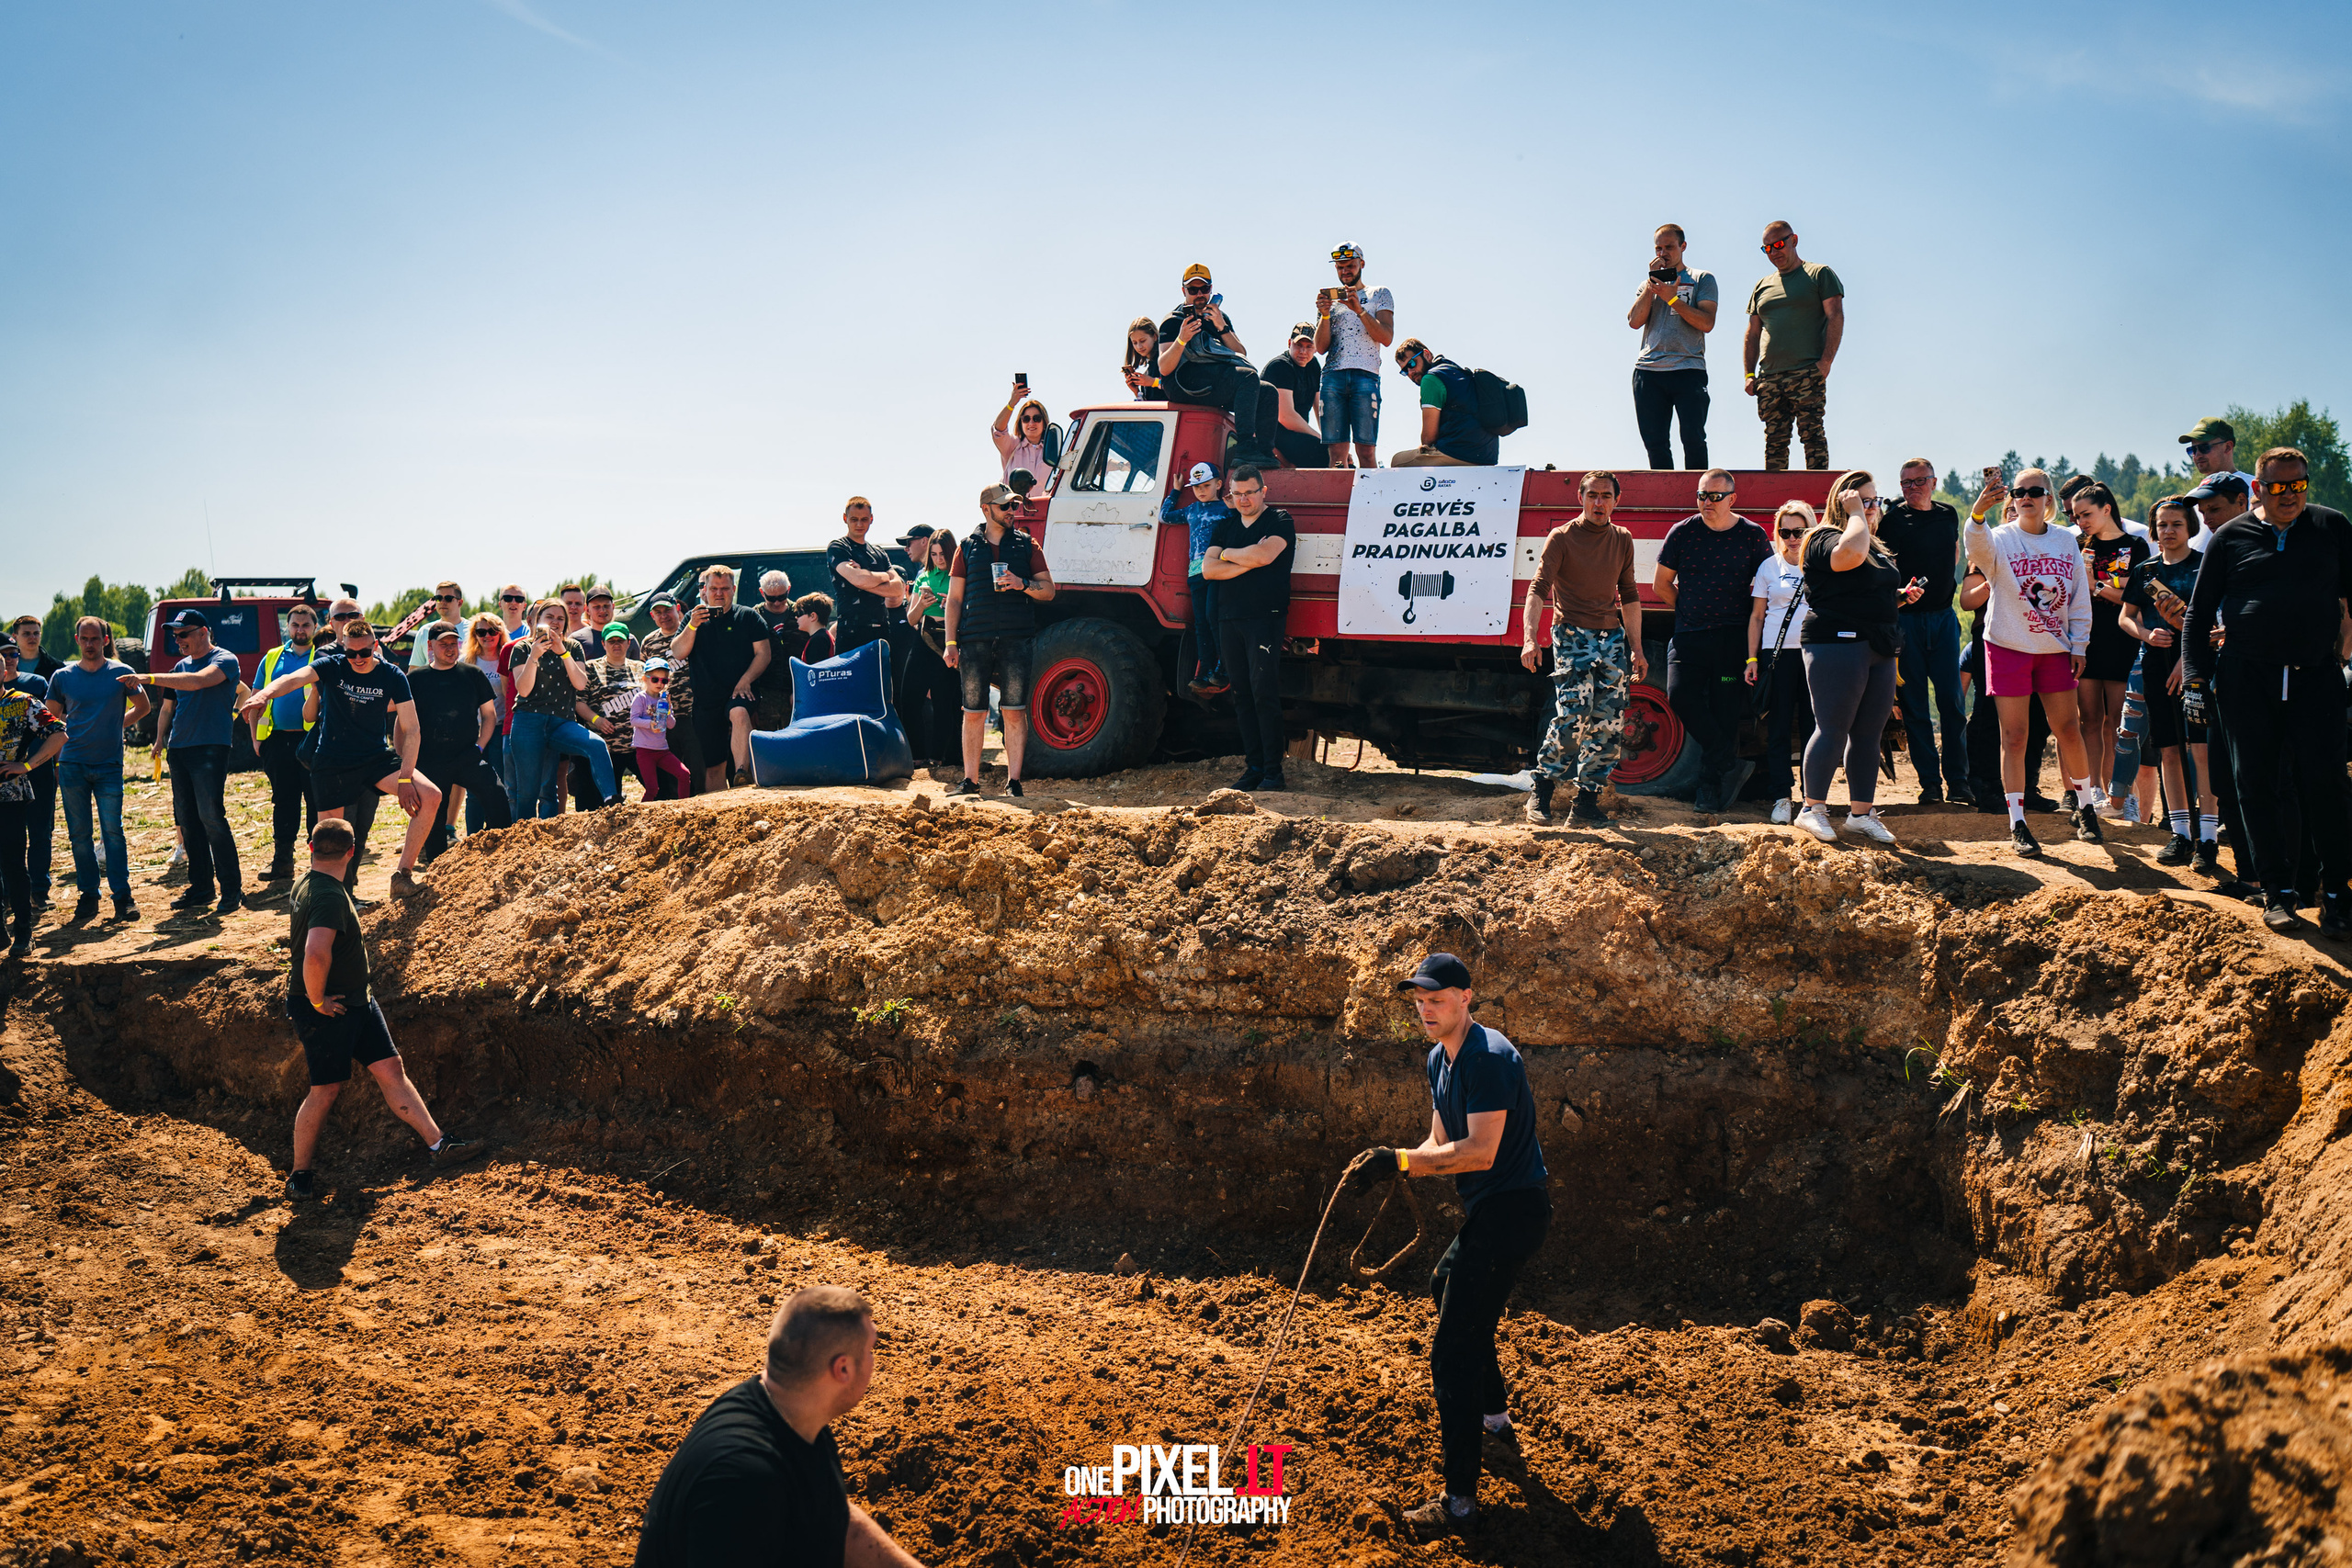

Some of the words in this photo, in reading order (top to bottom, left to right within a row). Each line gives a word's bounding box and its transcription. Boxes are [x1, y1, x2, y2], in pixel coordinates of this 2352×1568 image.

[1393, 499, 1476, 517] GERVĖS
[1383, 521, 1481, 537] PAGALBA
[1351, 542, 1508, 558] PRADINUKAMS
[819, 670, 853, 679] PTuras
[356, 686, 384, 695] TAILOR
